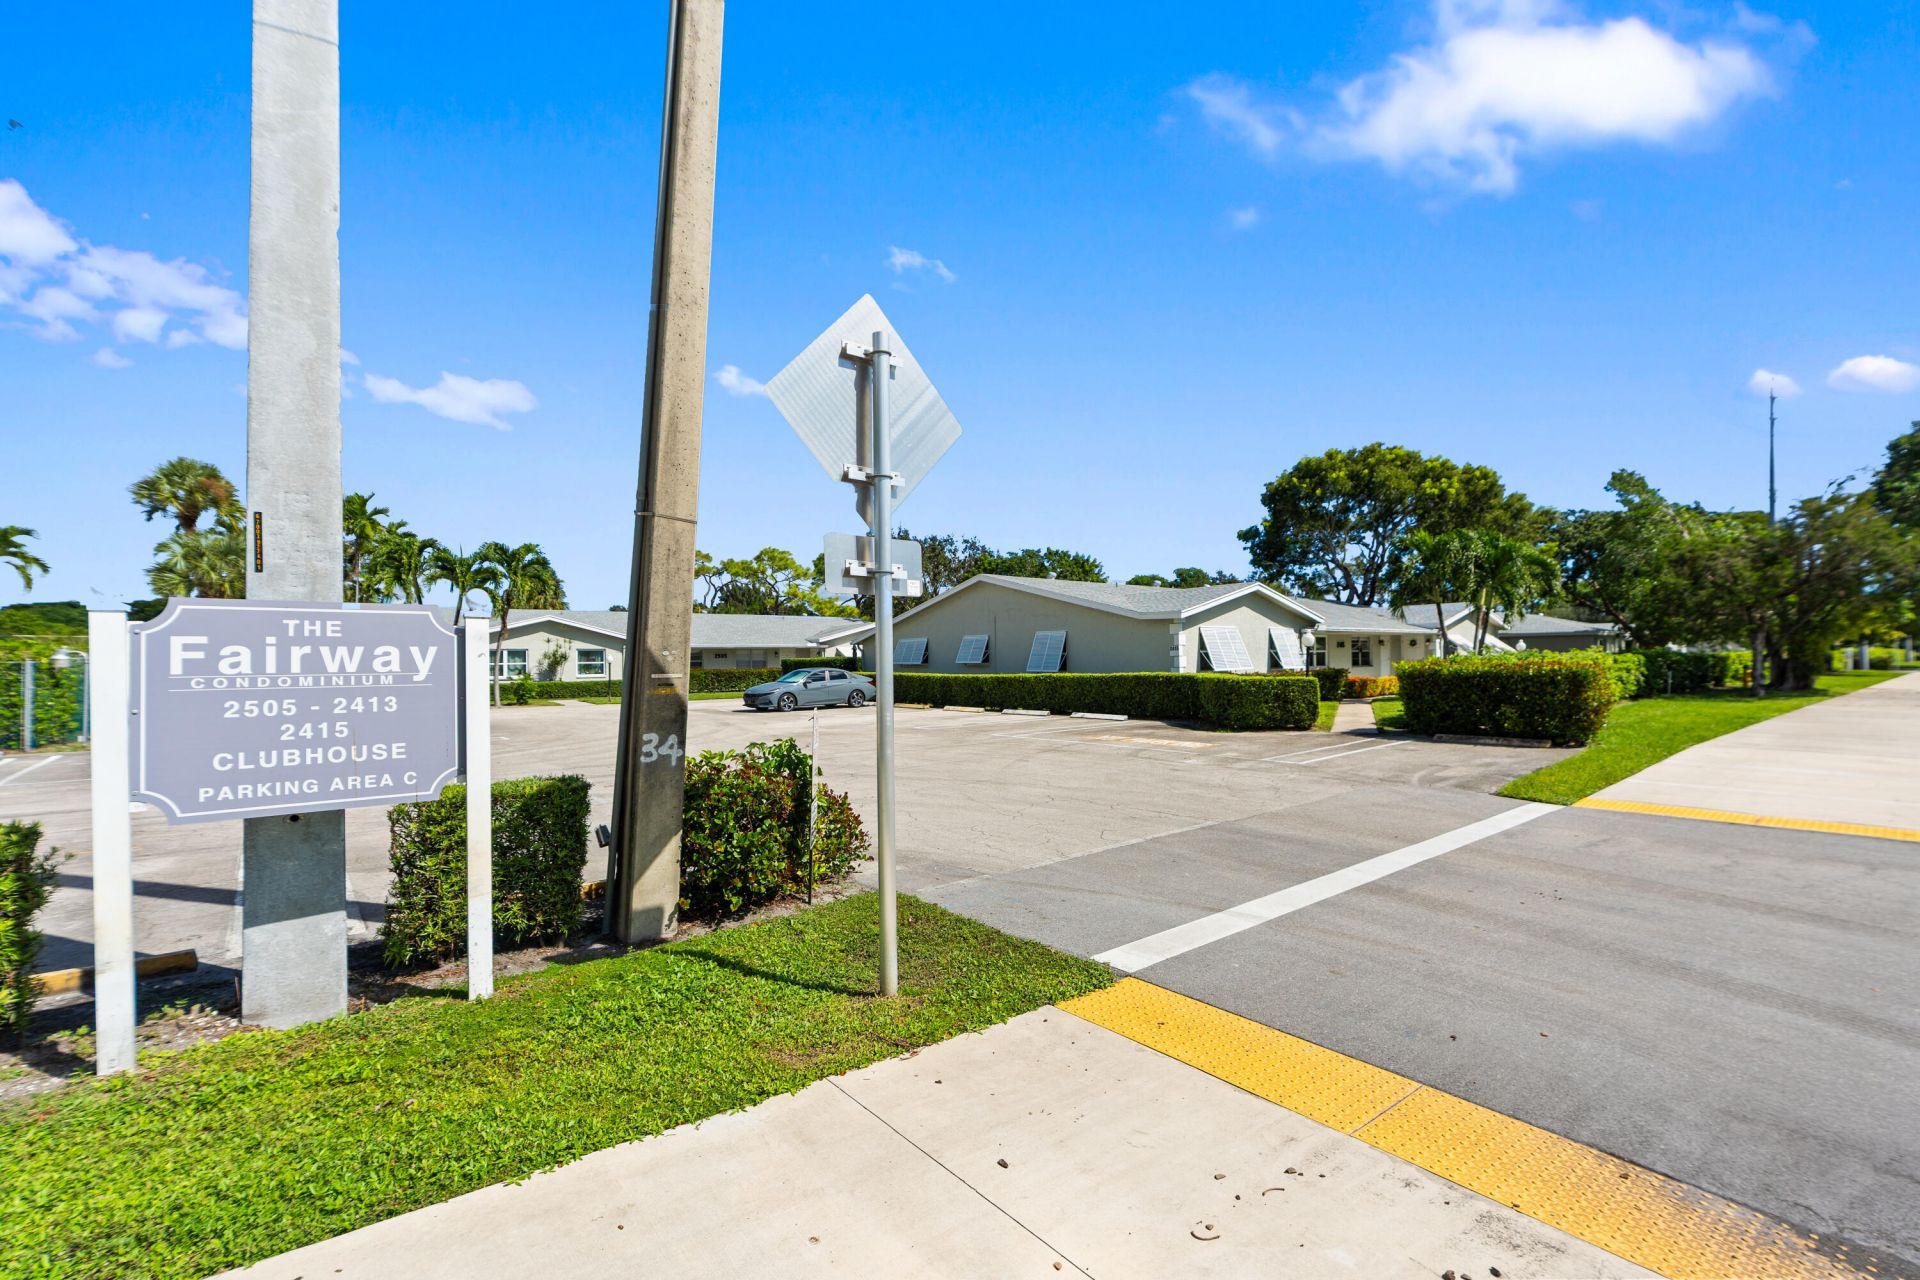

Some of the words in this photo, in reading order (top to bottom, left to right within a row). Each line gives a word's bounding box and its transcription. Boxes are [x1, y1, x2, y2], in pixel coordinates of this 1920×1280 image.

[283, 619, 342, 637] THE
[169, 635, 438, 682] Fairway
[190, 674, 394, 690] CONDOMINIUM
[223, 699, 297, 718] 2505
[332, 696, 398, 715] 2413
[280, 722, 349, 741] 2415
[212, 742, 407, 771] CLUBHOUSE
[640, 732, 683, 766] 34
[199, 778, 319, 802] PARKING
[330, 773, 394, 792] AREA
[403, 771, 418, 785] C
